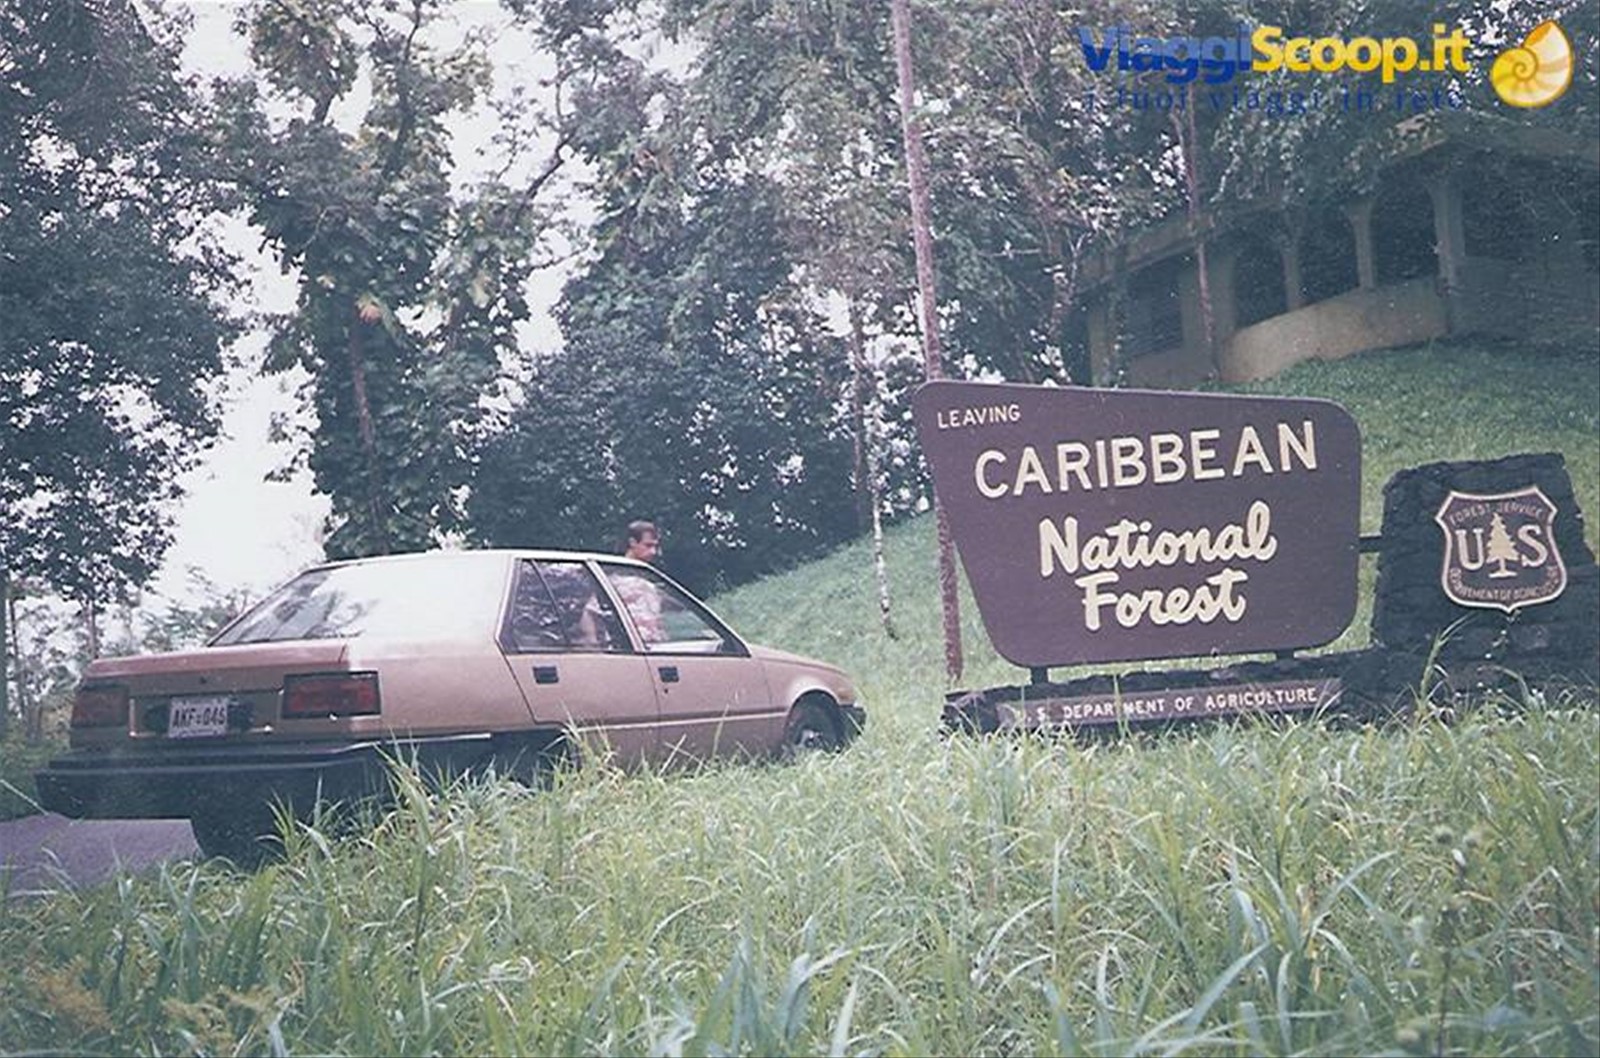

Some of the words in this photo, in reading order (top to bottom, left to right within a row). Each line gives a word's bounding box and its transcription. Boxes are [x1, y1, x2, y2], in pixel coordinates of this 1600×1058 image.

[938, 404, 1021, 429] LEAVING
[974, 420, 1318, 498] CARIBBEAN
[1039, 501, 1277, 577] National
[1455, 527, 1485, 571] U
[1517, 524, 1549, 567] S
[1074, 567, 1248, 631] Forest
[1062, 698, 1166, 720] DEPARMENT
[1174, 696, 1194, 712] OF
[1205, 687, 1317, 710] AGRICULTURE
